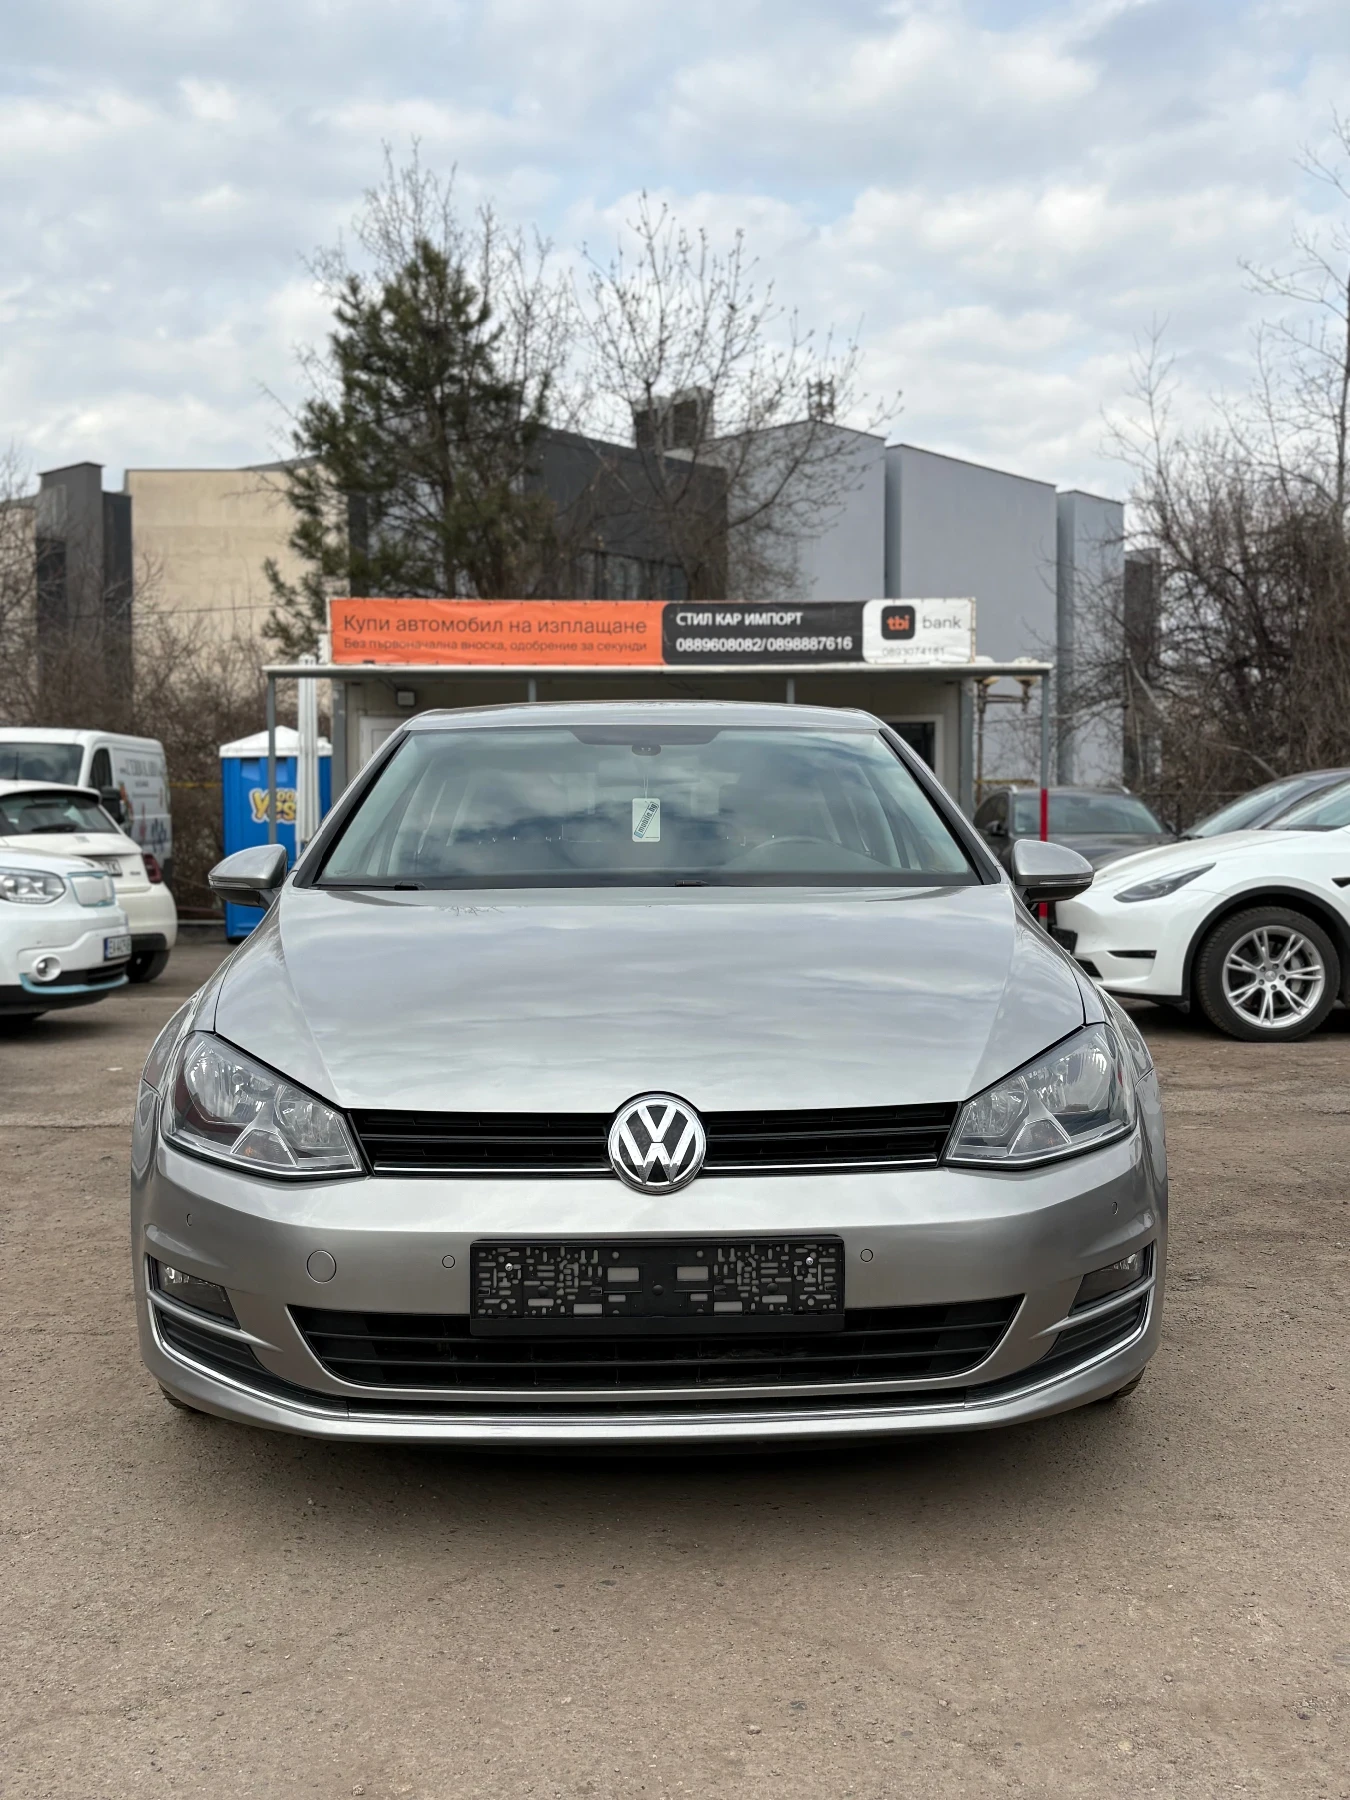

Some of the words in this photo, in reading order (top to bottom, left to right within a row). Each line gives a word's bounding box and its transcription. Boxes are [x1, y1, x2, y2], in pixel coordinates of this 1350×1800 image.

[343, 615, 390, 633] Купи
[396, 616, 503, 632] автомобил
[509, 620, 532, 633] на
[538, 620, 647, 635] изплащане
[675, 612, 712, 625] СТИЛ
[715, 612, 742, 625] КАР
[744, 611, 803, 625] ИМПОРТ
[886, 614, 910, 631] tbi
[922, 615, 961, 629] bank
[343, 638, 366, 648] Без
[369, 640, 458, 652] първоначална
[461, 641, 507, 651] вноска,
[510, 640, 578, 652] одобрение
[581, 642, 595, 651] за
[597, 641, 647, 652] секунди
[675, 635, 853, 652] 0889608082/0898887616
[637, 803, 658, 834] mobile.bg
